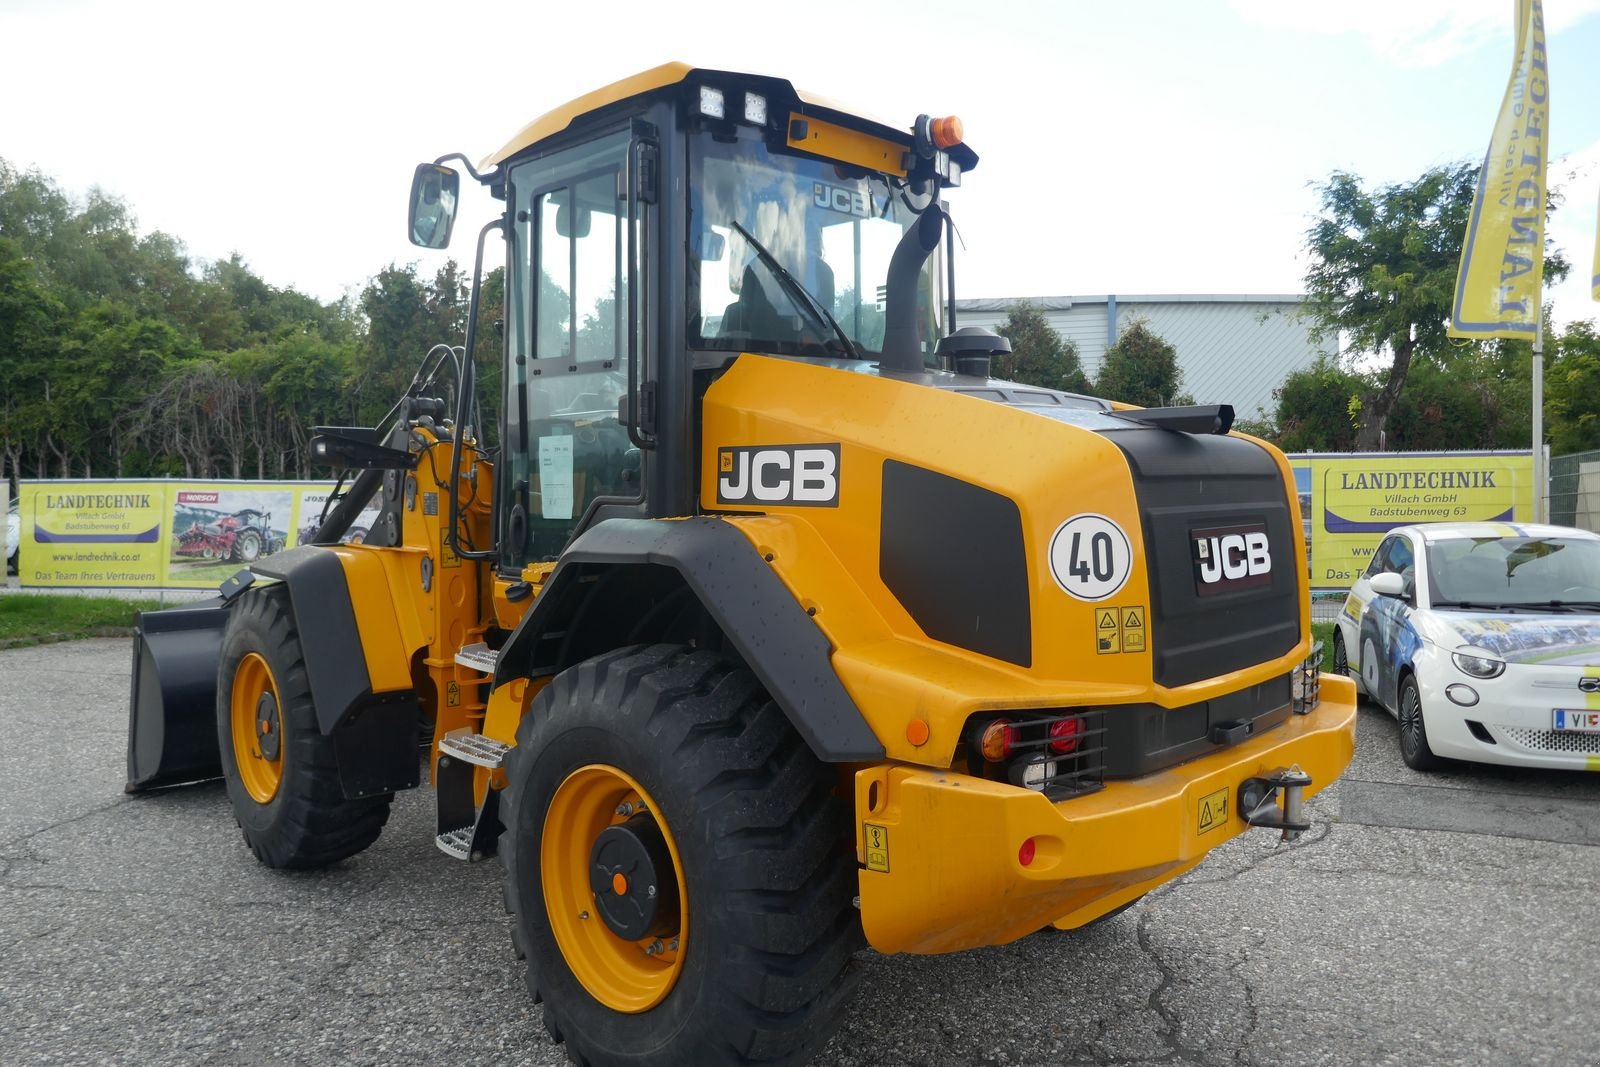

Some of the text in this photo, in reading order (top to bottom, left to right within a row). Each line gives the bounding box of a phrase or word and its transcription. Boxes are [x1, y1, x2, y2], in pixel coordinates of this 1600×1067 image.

[814, 185, 871, 219] JCB
[720, 449, 837, 502] JCB
[1341, 471, 1496, 490] LANDTECHNIK
[46, 494, 151, 509] LANDTECHNIK
[1385, 494, 1457, 504] Villach GmbH
[1369, 507, 1467, 517] Badstubenweg 63
[1069, 531, 1114, 583] 40
[1200, 532, 1272, 584] JCB
[35, 571, 156, 581] Das Team Ihres Vertrauens
[1326, 569, 1350, 579] Das
[1578, 677, 1600, 693] 5
